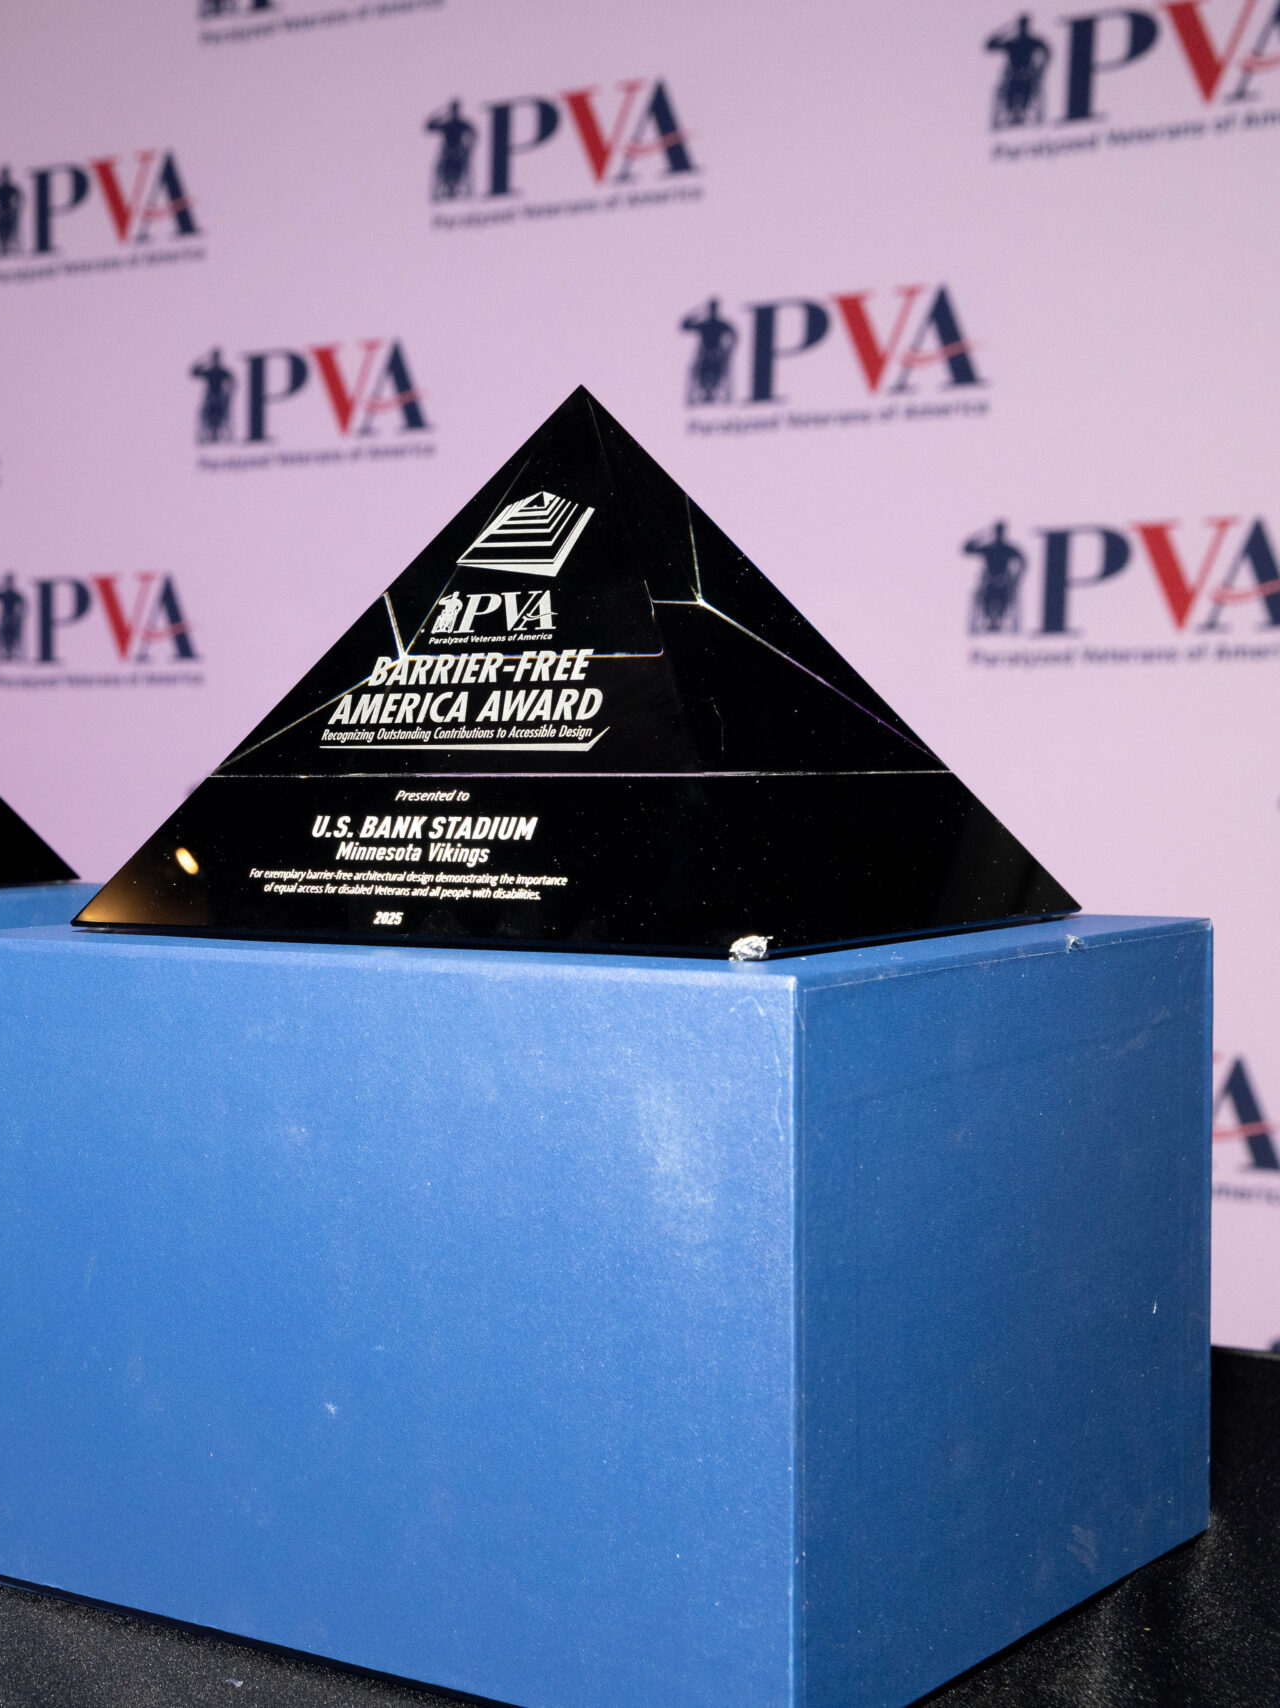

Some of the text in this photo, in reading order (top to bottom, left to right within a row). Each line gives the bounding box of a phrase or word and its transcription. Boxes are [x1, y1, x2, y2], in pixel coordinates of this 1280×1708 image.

[483, 76, 706, 197] PVA
[31, 149, 205, 254] PVA
[746, 283, 990, 404] PVA
[243, 336, 433, 443] PVA
[33, 571, 204, 664] PVA
[453, 590, 557, 633] PVA
[429, 636, 468, 645] Paralyzed
[517, 633, 553, 641] America
[1219, 642, 1280, 663] Amer
[368, 649, 594, 686] BARRIER-FREE
[328, 688, 603, 724] AMERICA AWARD
[321, 724, 593, 743] Recognizing Outstanding Contributions to Accessible Design
[395, 790, 470, 801] Presented to
[312, 815, 538, 841] U.S. BANK STADIUM
[336, 842, 490, 867] Minnesota Vikings
[249, 868, 568, 887] For exemplary barrier-free architectural design demonstrating the importance
[263, 882, 541, 900] of equal access for disabled Veterans and all people with disabilities.
[373, 911, 404, 925] 2025
